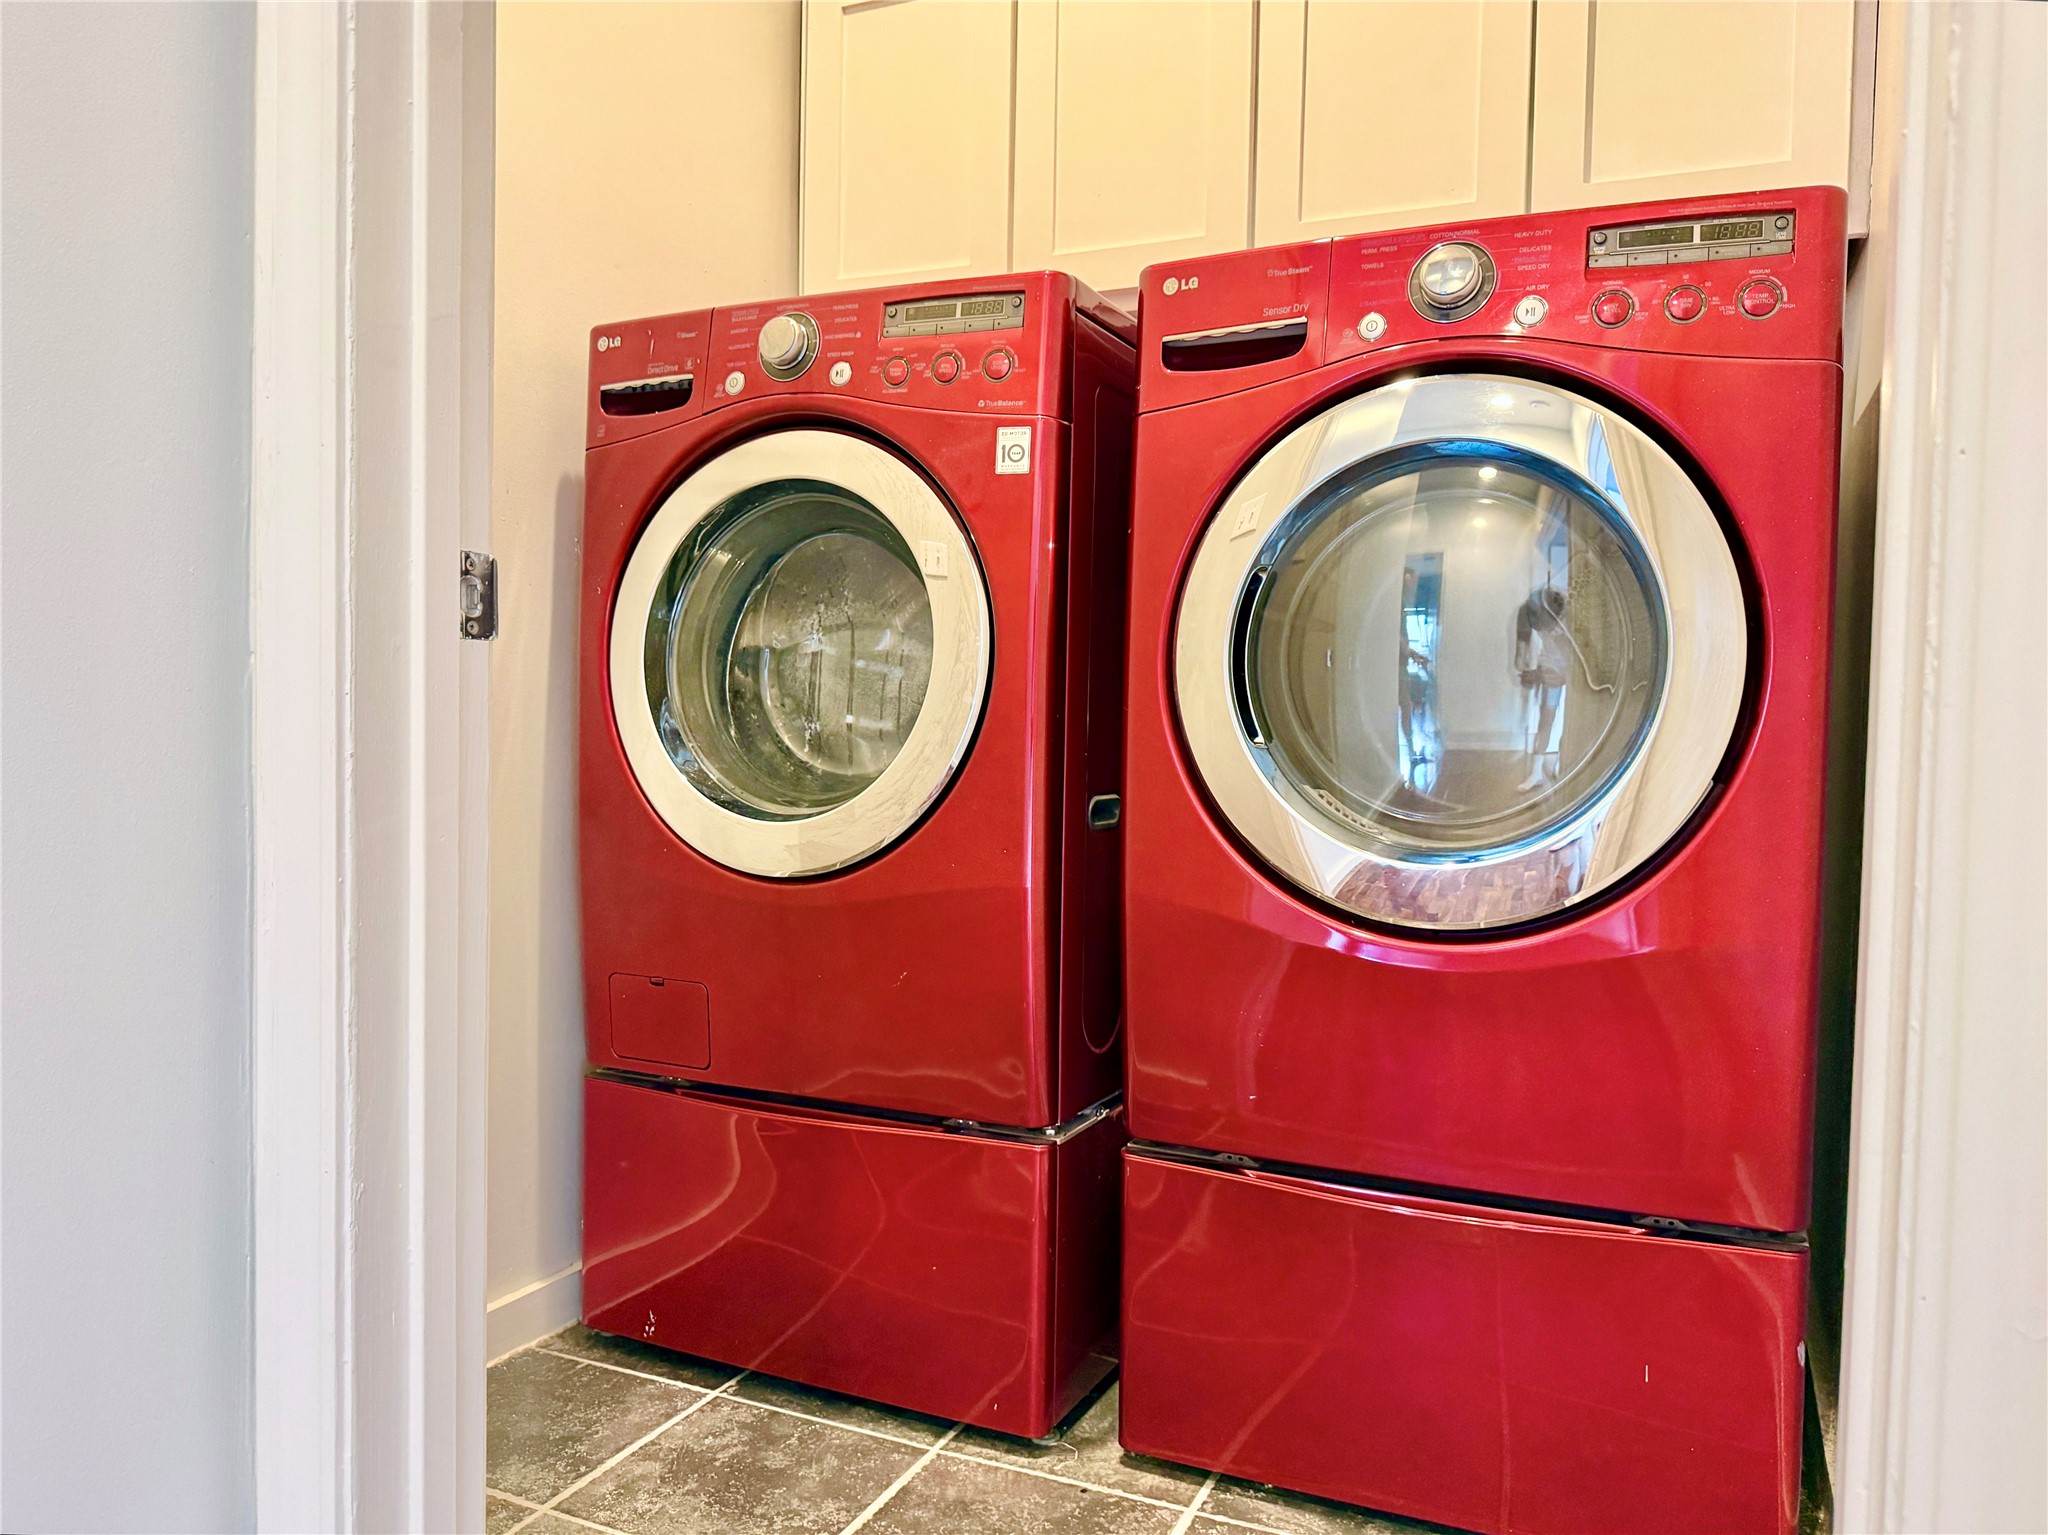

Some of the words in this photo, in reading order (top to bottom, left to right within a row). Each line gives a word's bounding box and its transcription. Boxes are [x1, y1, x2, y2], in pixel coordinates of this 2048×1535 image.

[1181, 276, 1199, 291] LG
[1263, 306, 1292, 317] Sensor
[1293, 303, 1309, 313] Dry
[647, 366, 664, 374] Direct
[664, 365, 678, 373] Drive
[1001, 444, 1026, 463] 10
